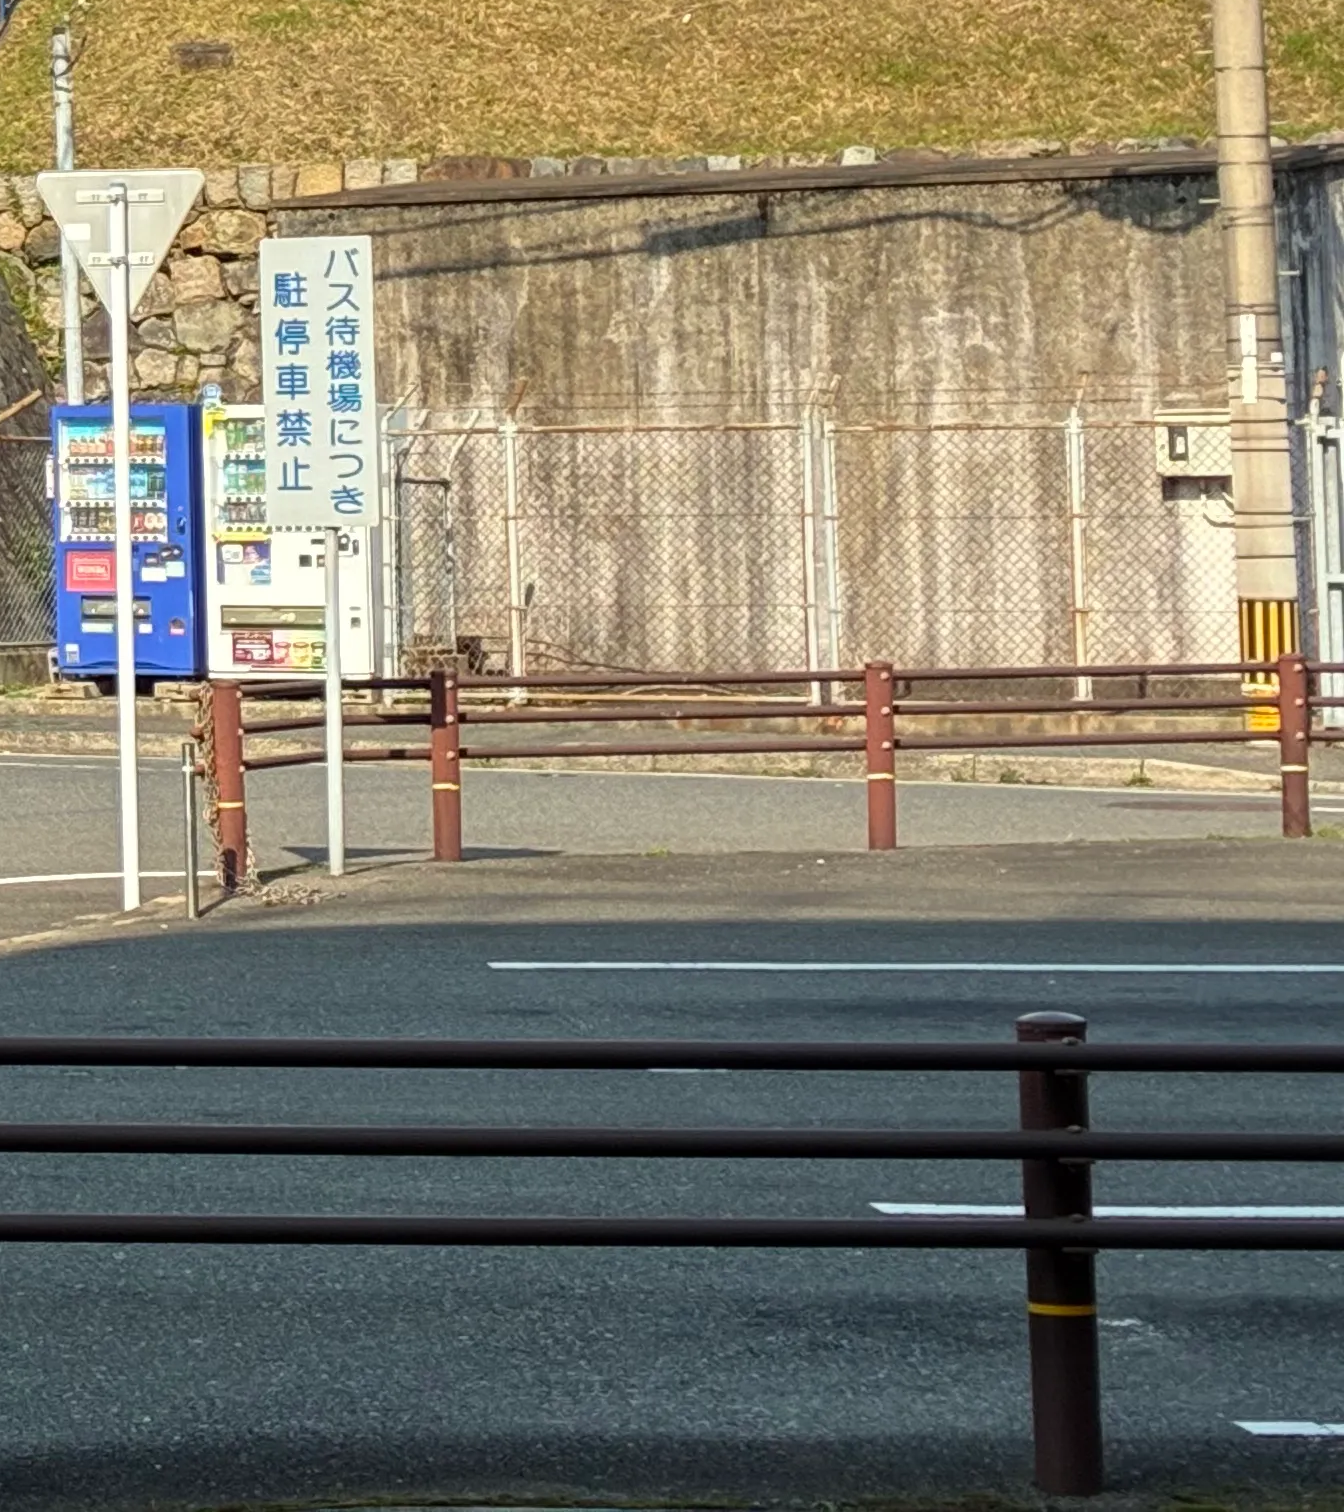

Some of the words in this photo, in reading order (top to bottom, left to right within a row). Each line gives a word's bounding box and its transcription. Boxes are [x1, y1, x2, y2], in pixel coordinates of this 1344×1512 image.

[273, 271, 313, 492] 駐停車禁止
[323, 247, 364, 516] バス待機場につき
